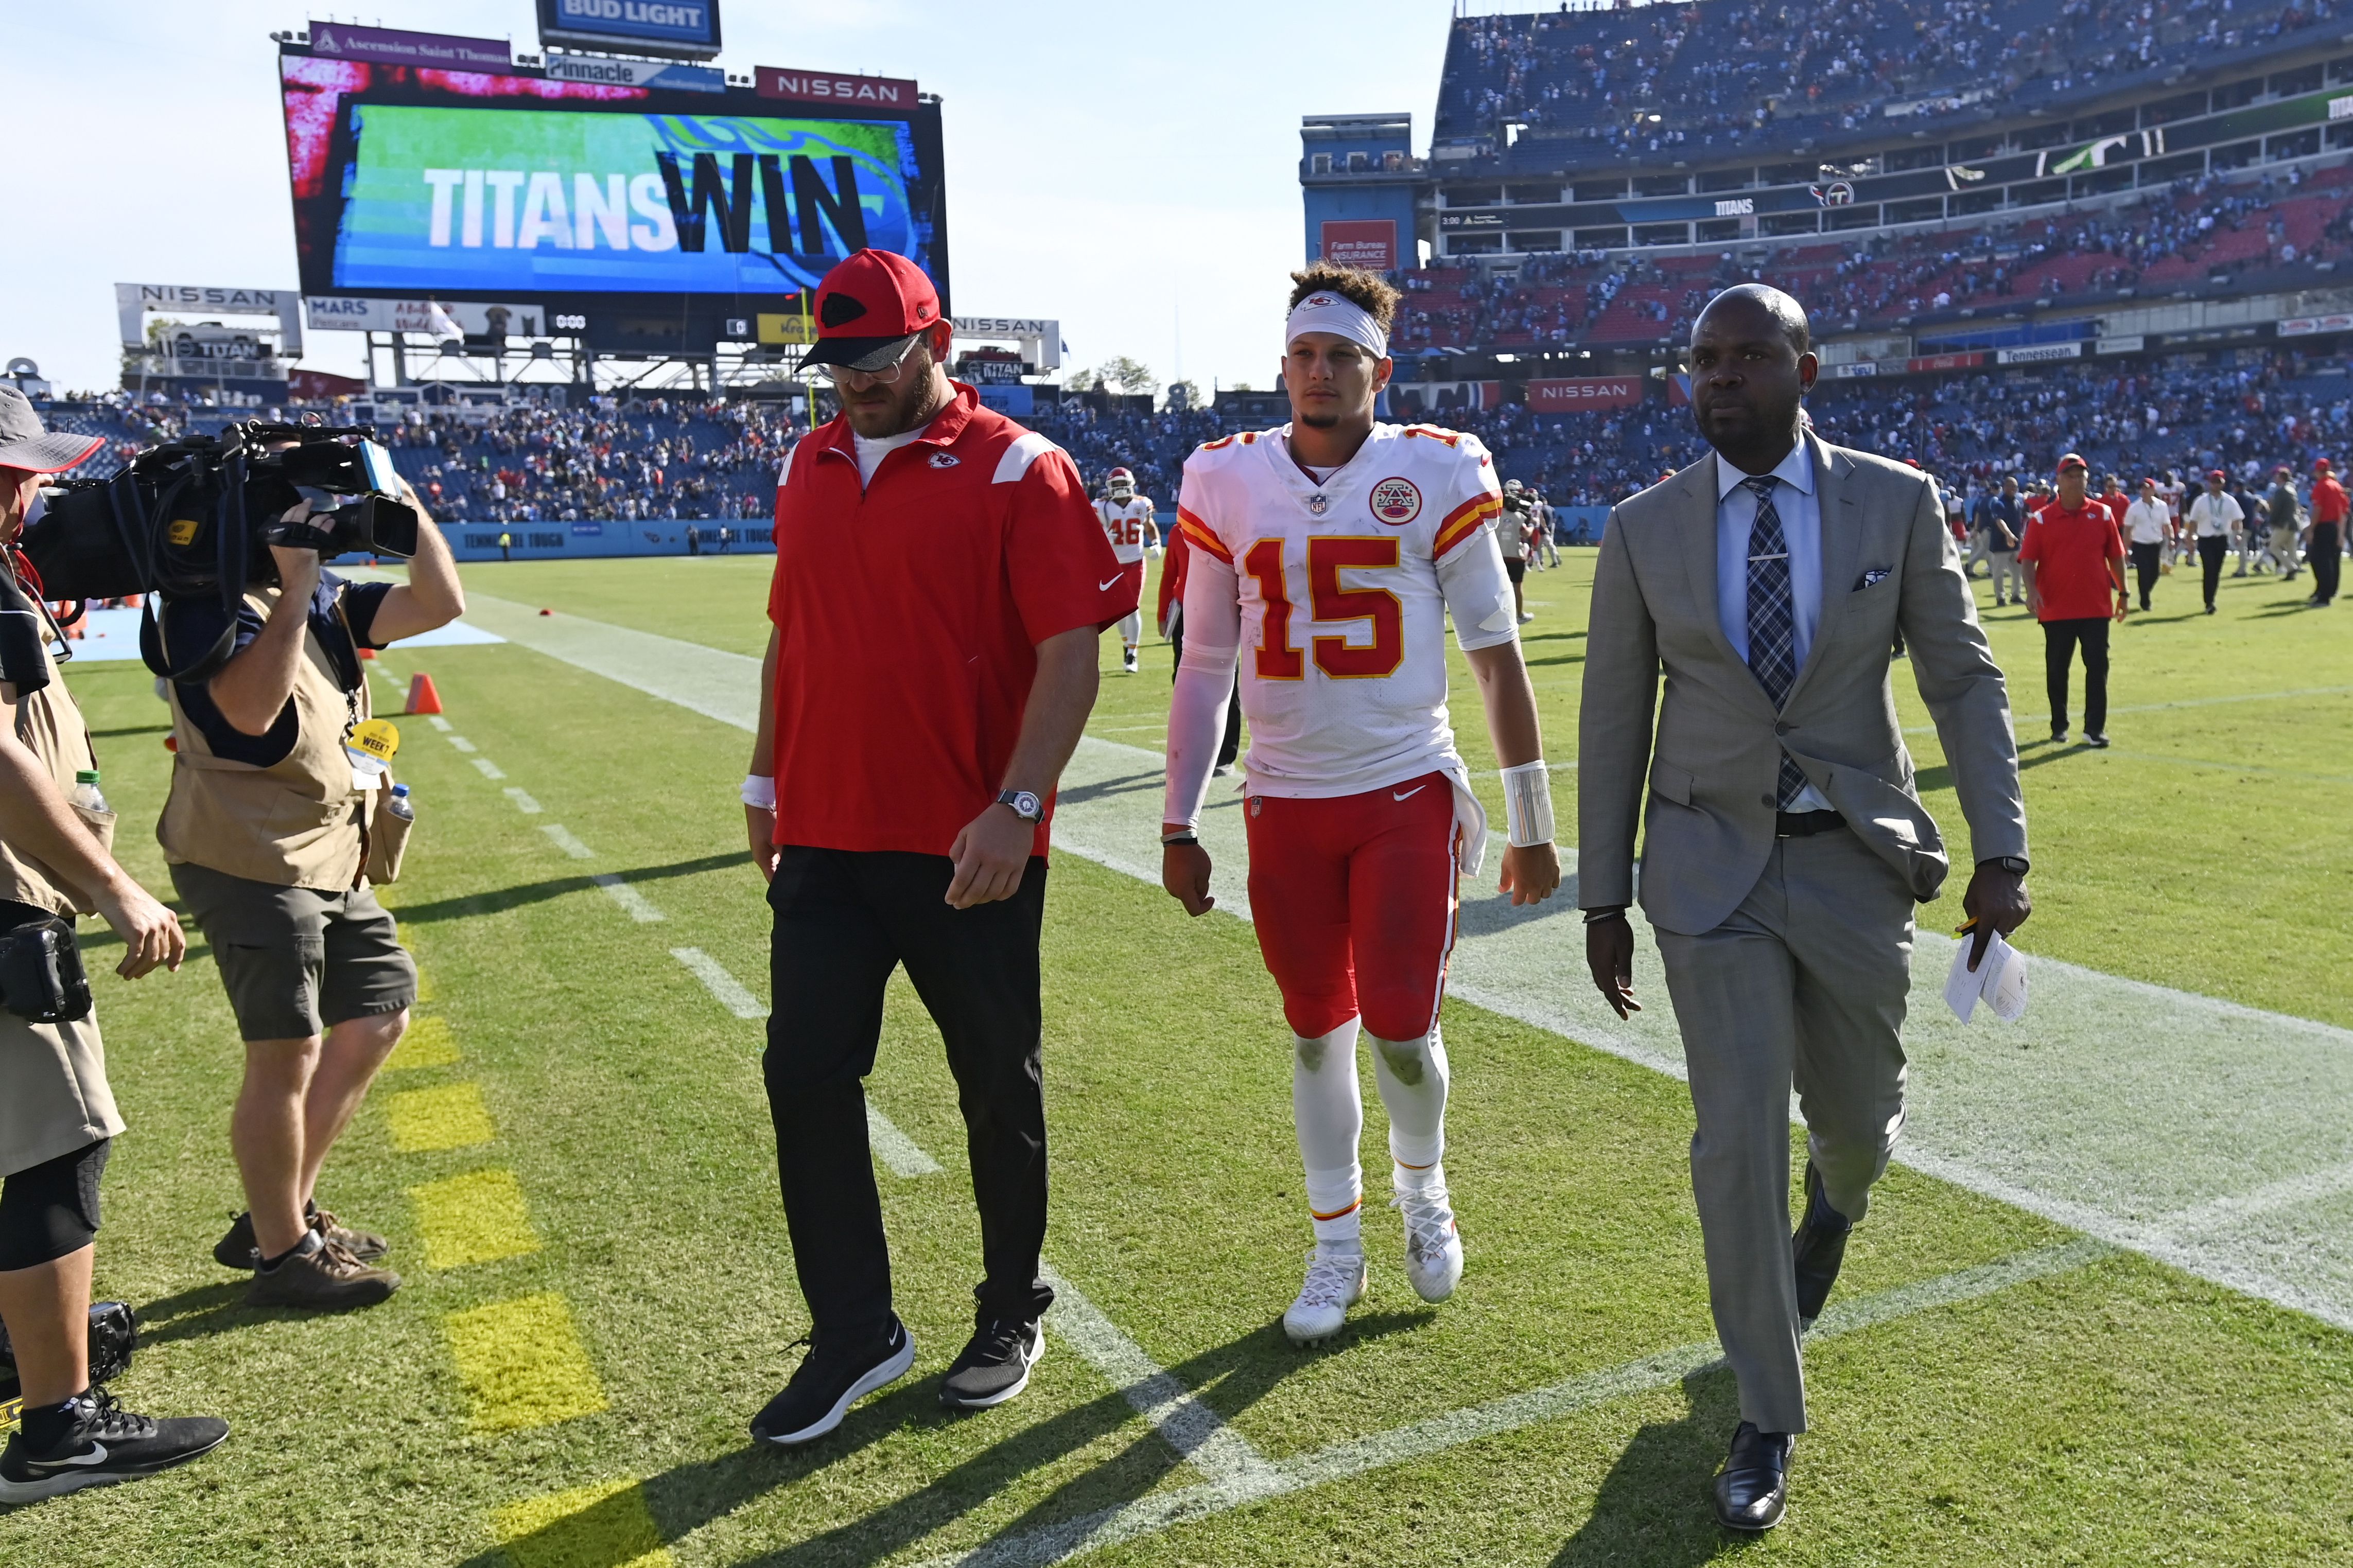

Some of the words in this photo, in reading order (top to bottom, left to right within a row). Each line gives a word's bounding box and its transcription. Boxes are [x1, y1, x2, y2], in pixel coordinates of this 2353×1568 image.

[564, 0, 621, 19] BUD
[624, 2, 701, 27] LIGHT
[344, 36, 416, 55] Ascension
[419, 44, 455, 59] Saint
[456, 48, 510, 63] Thomas
[549, 58, 634, 82] Pinnacle
[777, 76, 898, 102] NISSAN
[423, 168, 681, 252] TITANS
[655, 150, 869, 255] WIN
[1714, 198, 1754, 216] TITANS
[1331, 241, 1355, 250] Farm
[1355, 241, 1386, 249] Bureau
[1330, 250, 1386, 260] INSURANCE
[141, 286, 275, 305] NISSAN
[311, 299, 368, 315] MARS
[556, 314, 586, 329] 0:00
[780, 317, 817, 341] Kroge
[953, 318, 1043, 332] NISSAN
[1542, 384, 1627, 398] NISSAN
[1313, 502, 1325, 512] NFL
[1107, 517, 1140, 545] 46
[465, 533, 524, 548] TENNEEE
[1243, 535, 1404, 680] 15
[362, 735, 385, 752] WEEK
